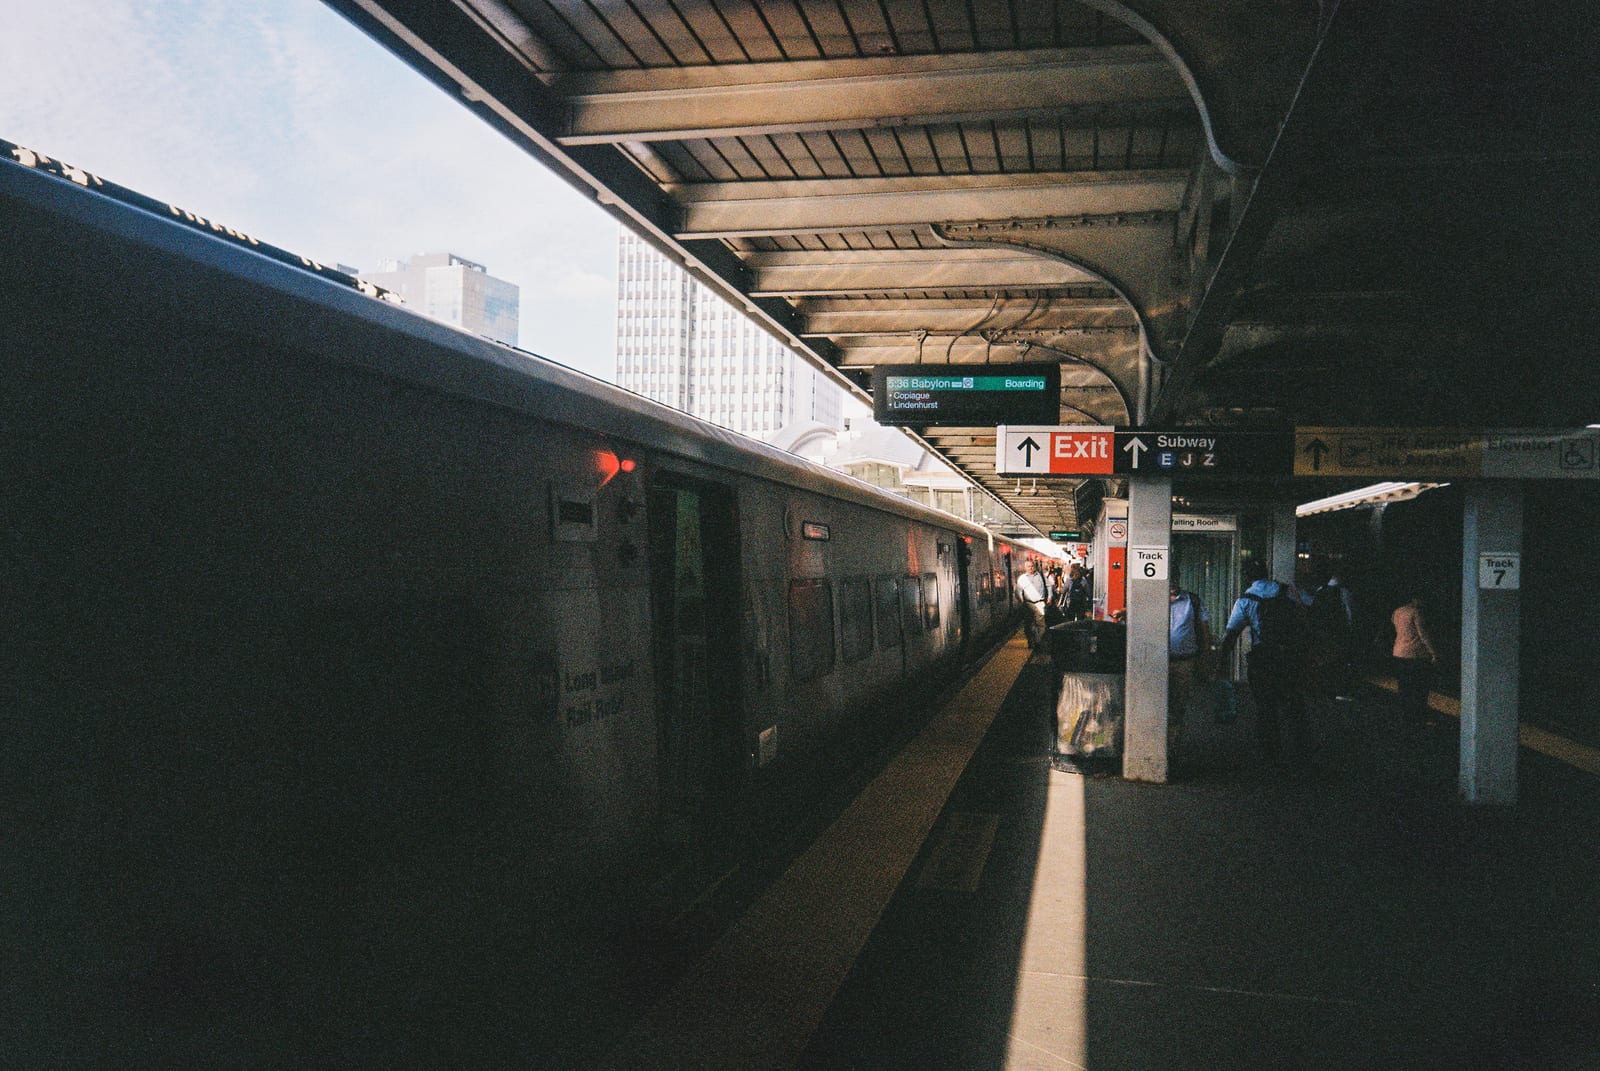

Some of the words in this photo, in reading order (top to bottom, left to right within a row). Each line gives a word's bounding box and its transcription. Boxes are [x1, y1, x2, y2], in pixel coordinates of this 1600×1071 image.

[911, 378, 951, 390] Babylon
[1005, 379, 1044, 390] Boarding
[893, 392, 931, 401] Copiague
[893, 401, 938, 410] Lindenhurst
[1054, 435, 1109, 459] Exit
[1156, 435, 1216, 450] Subway
[1161, 453, 1172, 466] E
[1182, 453, 1193, 466] J
[1203, 453, 1215, 466] Z
[1172, 519, 1195, 527] aiting
[1138, 552, 1163, 560] Track
[1486, 558, 1514, 569] Track
[1143, 562, 1156, 578] 6
[1493, 570, 1506, 586] 7
[564, 672, 597, 693] Long
